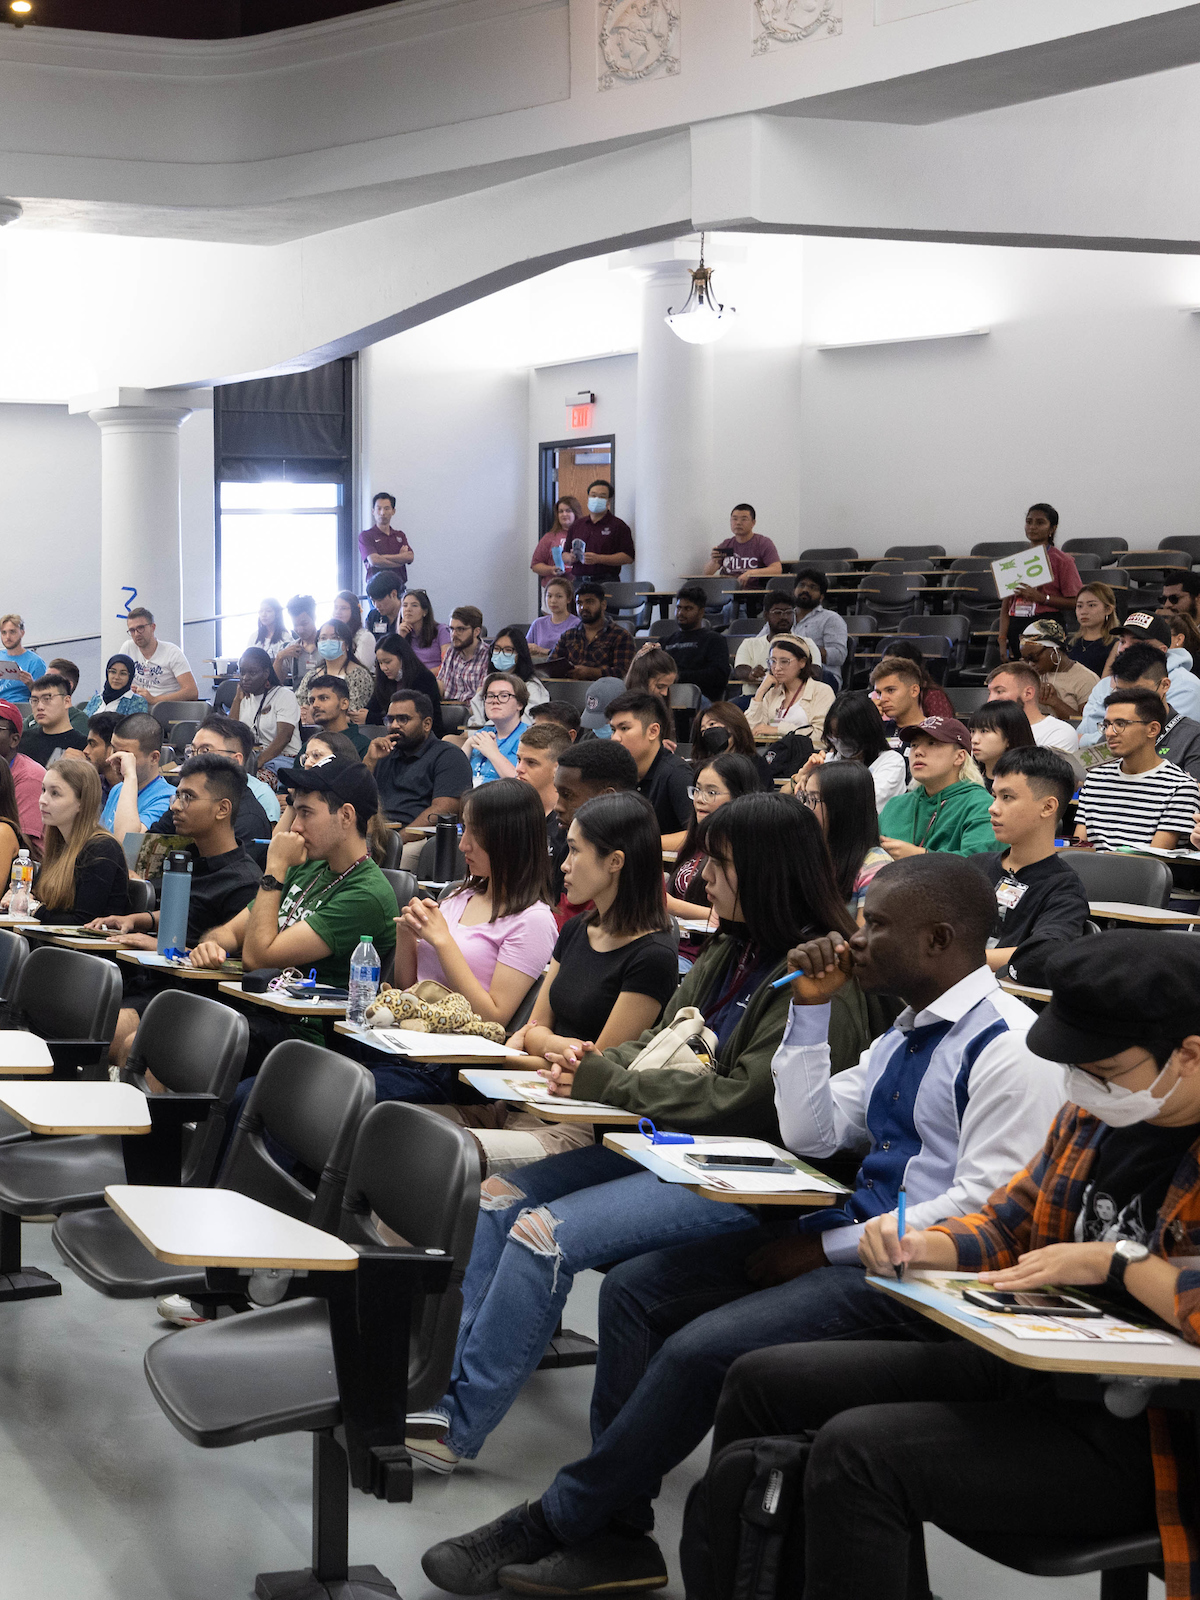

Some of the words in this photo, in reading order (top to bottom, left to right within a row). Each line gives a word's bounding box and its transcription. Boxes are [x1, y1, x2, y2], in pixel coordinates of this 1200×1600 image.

[571, 406, 588, 428] EXIT
[1023, 555, 1043, 578] 10
[116, 586, 138, 619] 3
